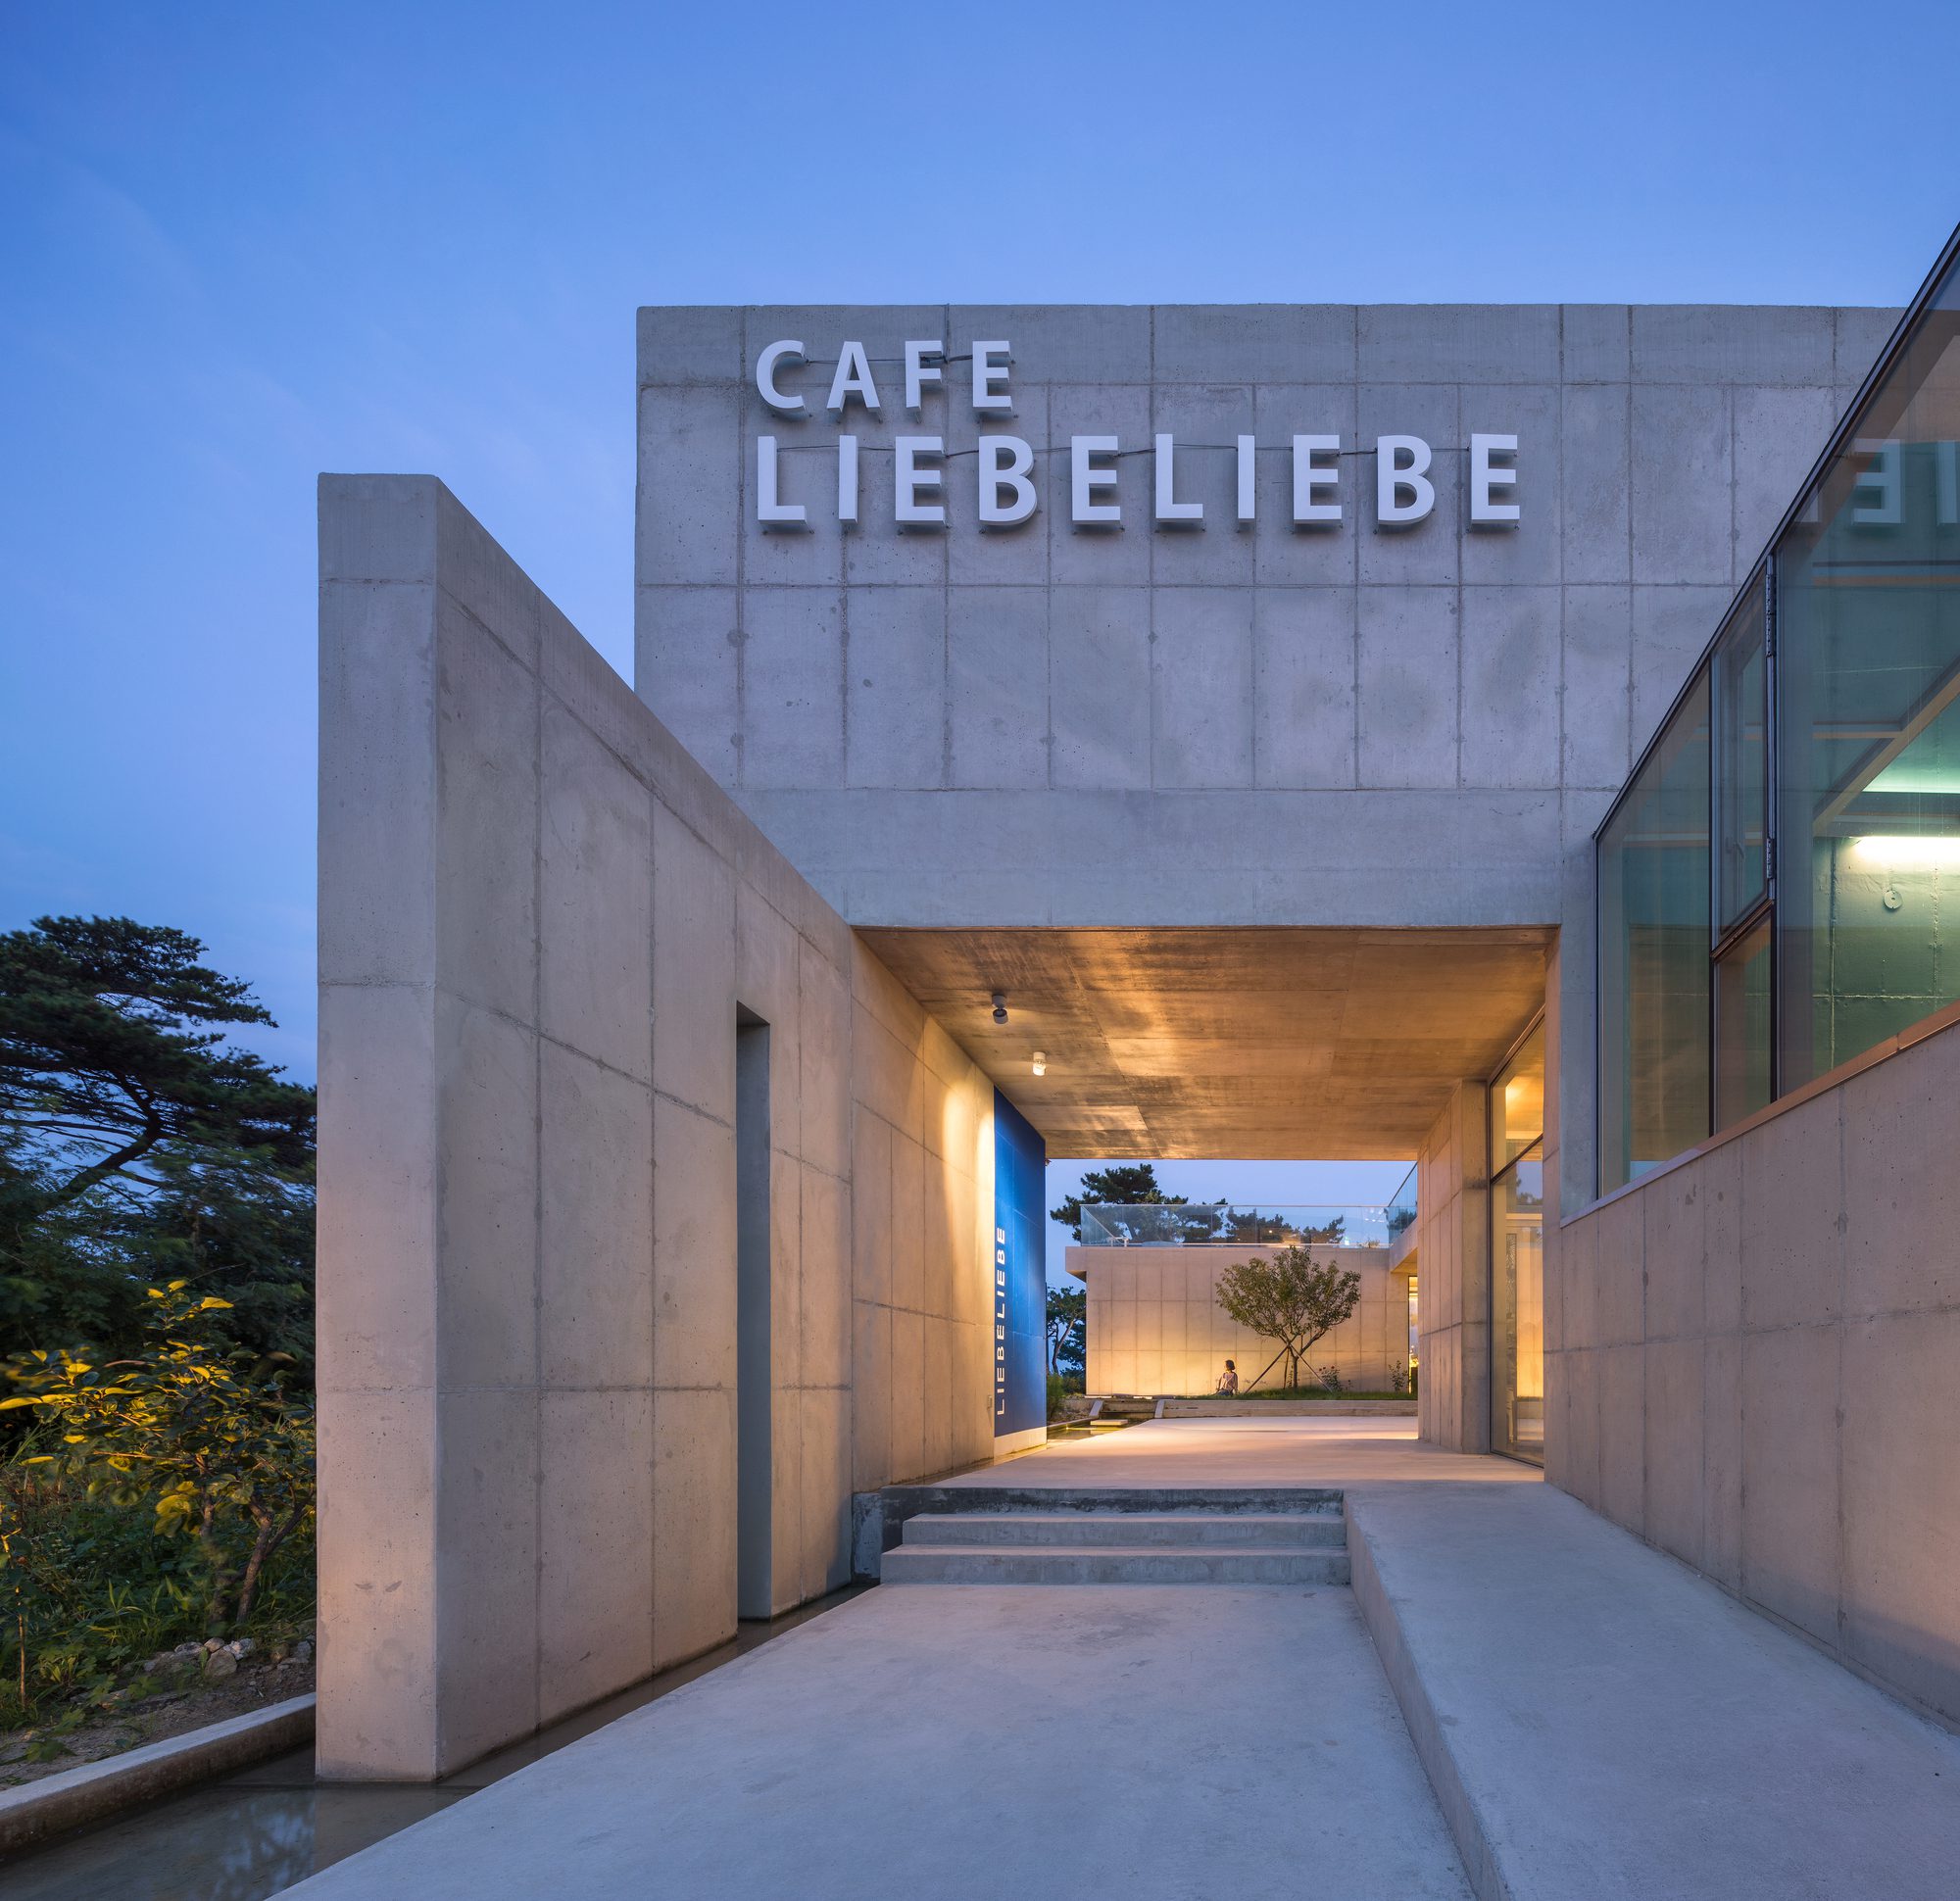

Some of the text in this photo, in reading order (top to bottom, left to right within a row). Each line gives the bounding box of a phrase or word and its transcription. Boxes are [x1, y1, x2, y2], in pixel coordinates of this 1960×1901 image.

[756, 339, 1013, 413] CAFE
[757, 433, 1520, 525] LIEBELIEBE
[997, 1227, 1005, 1415] LIEBELIEBE
